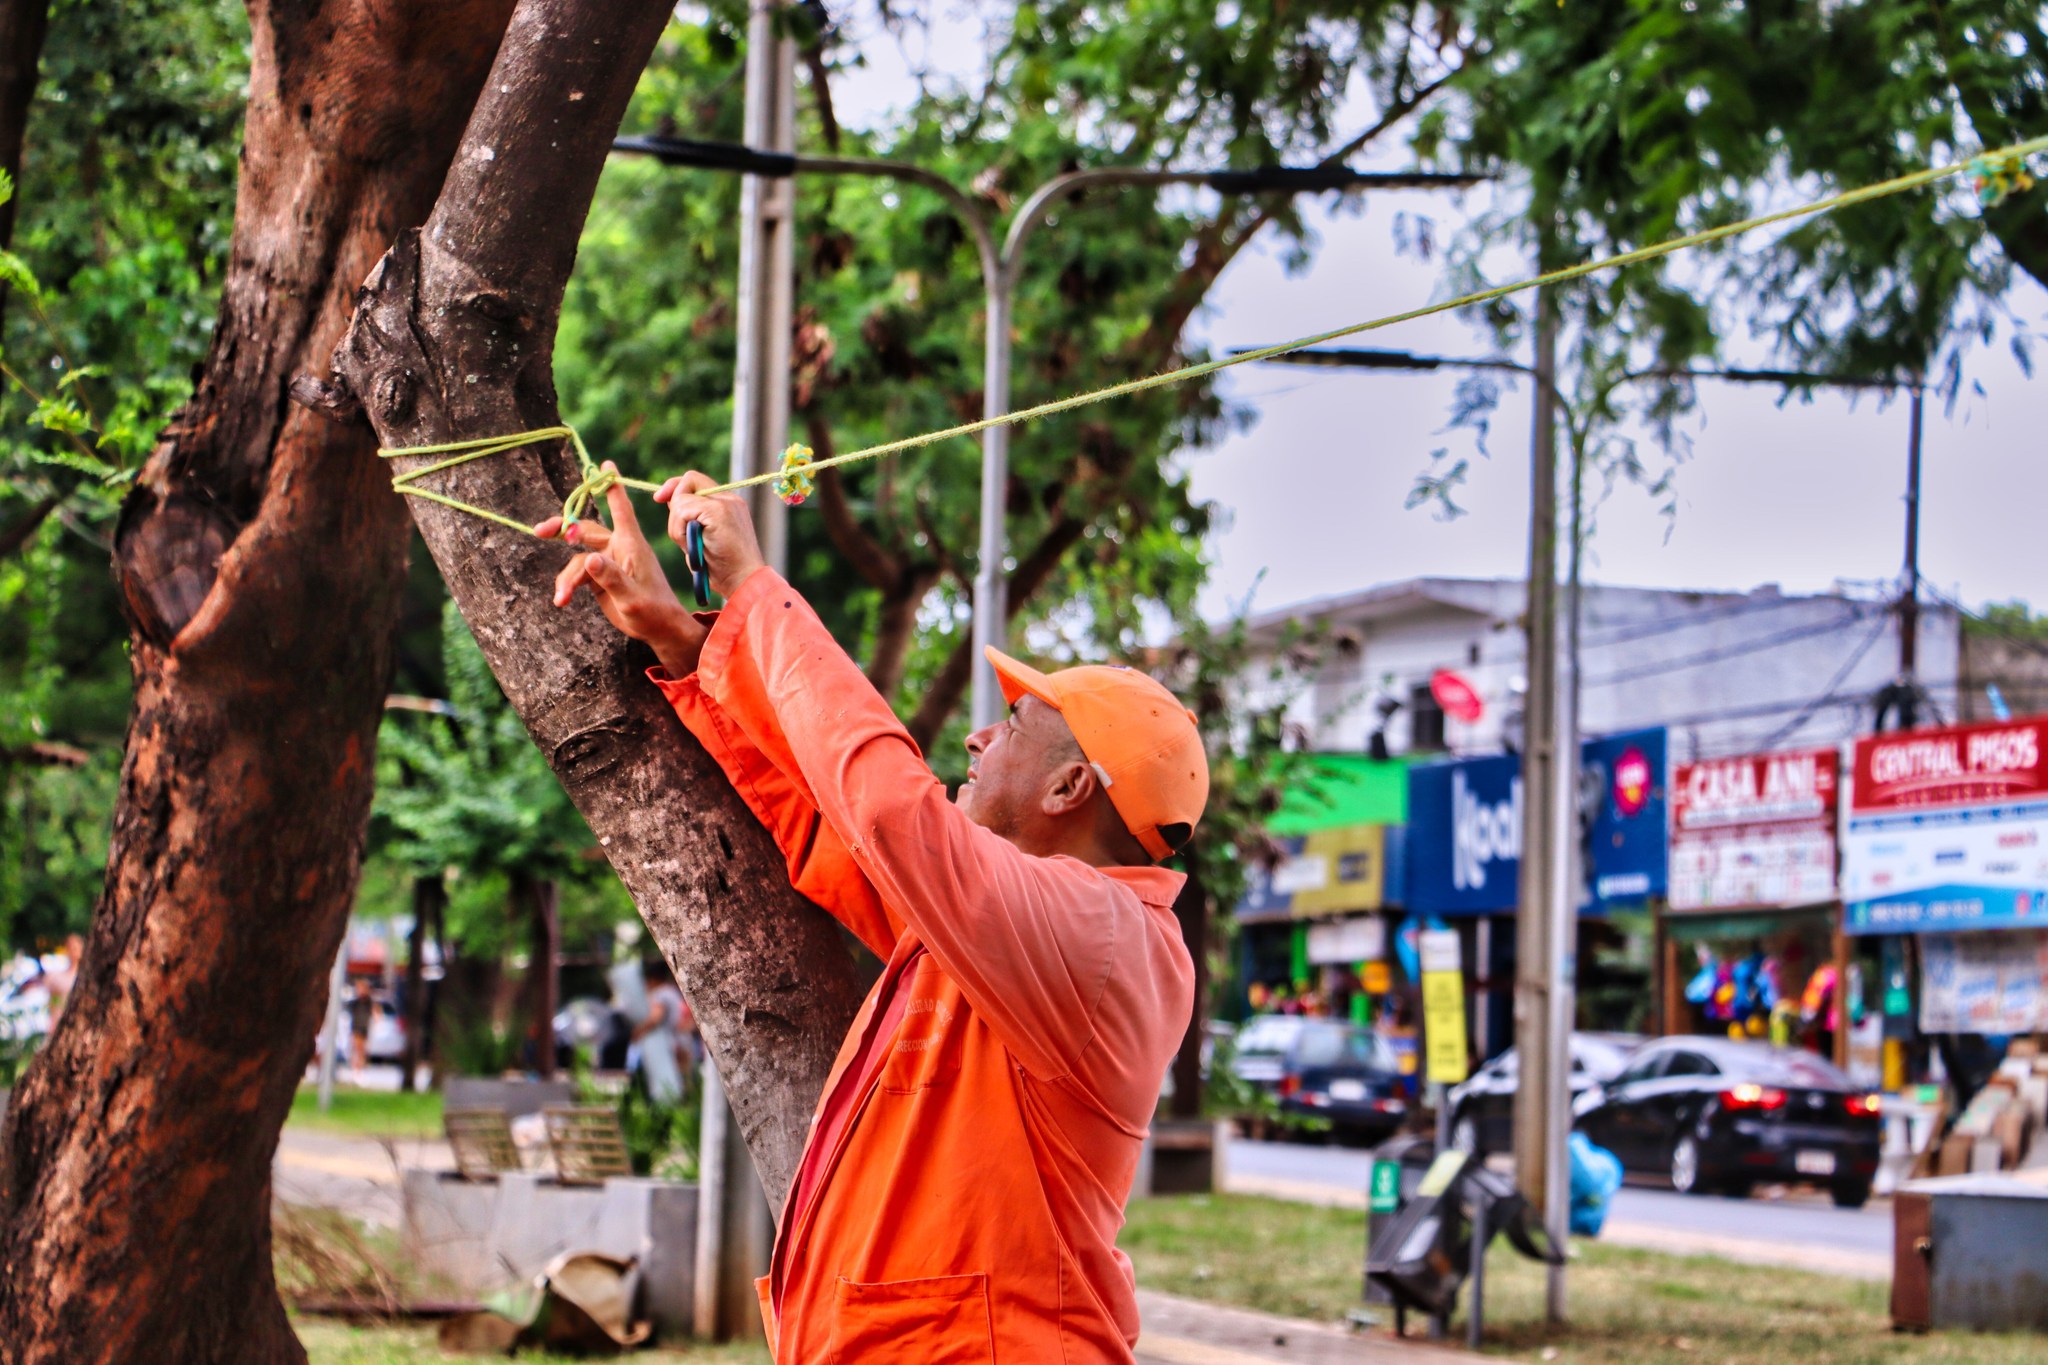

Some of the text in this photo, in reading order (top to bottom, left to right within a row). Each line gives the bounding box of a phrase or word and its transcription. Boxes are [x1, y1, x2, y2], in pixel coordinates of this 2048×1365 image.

[1870, 727, 2039, 783] CENTRAL PISOS
[1687, 763, 1756, 809] CASA
